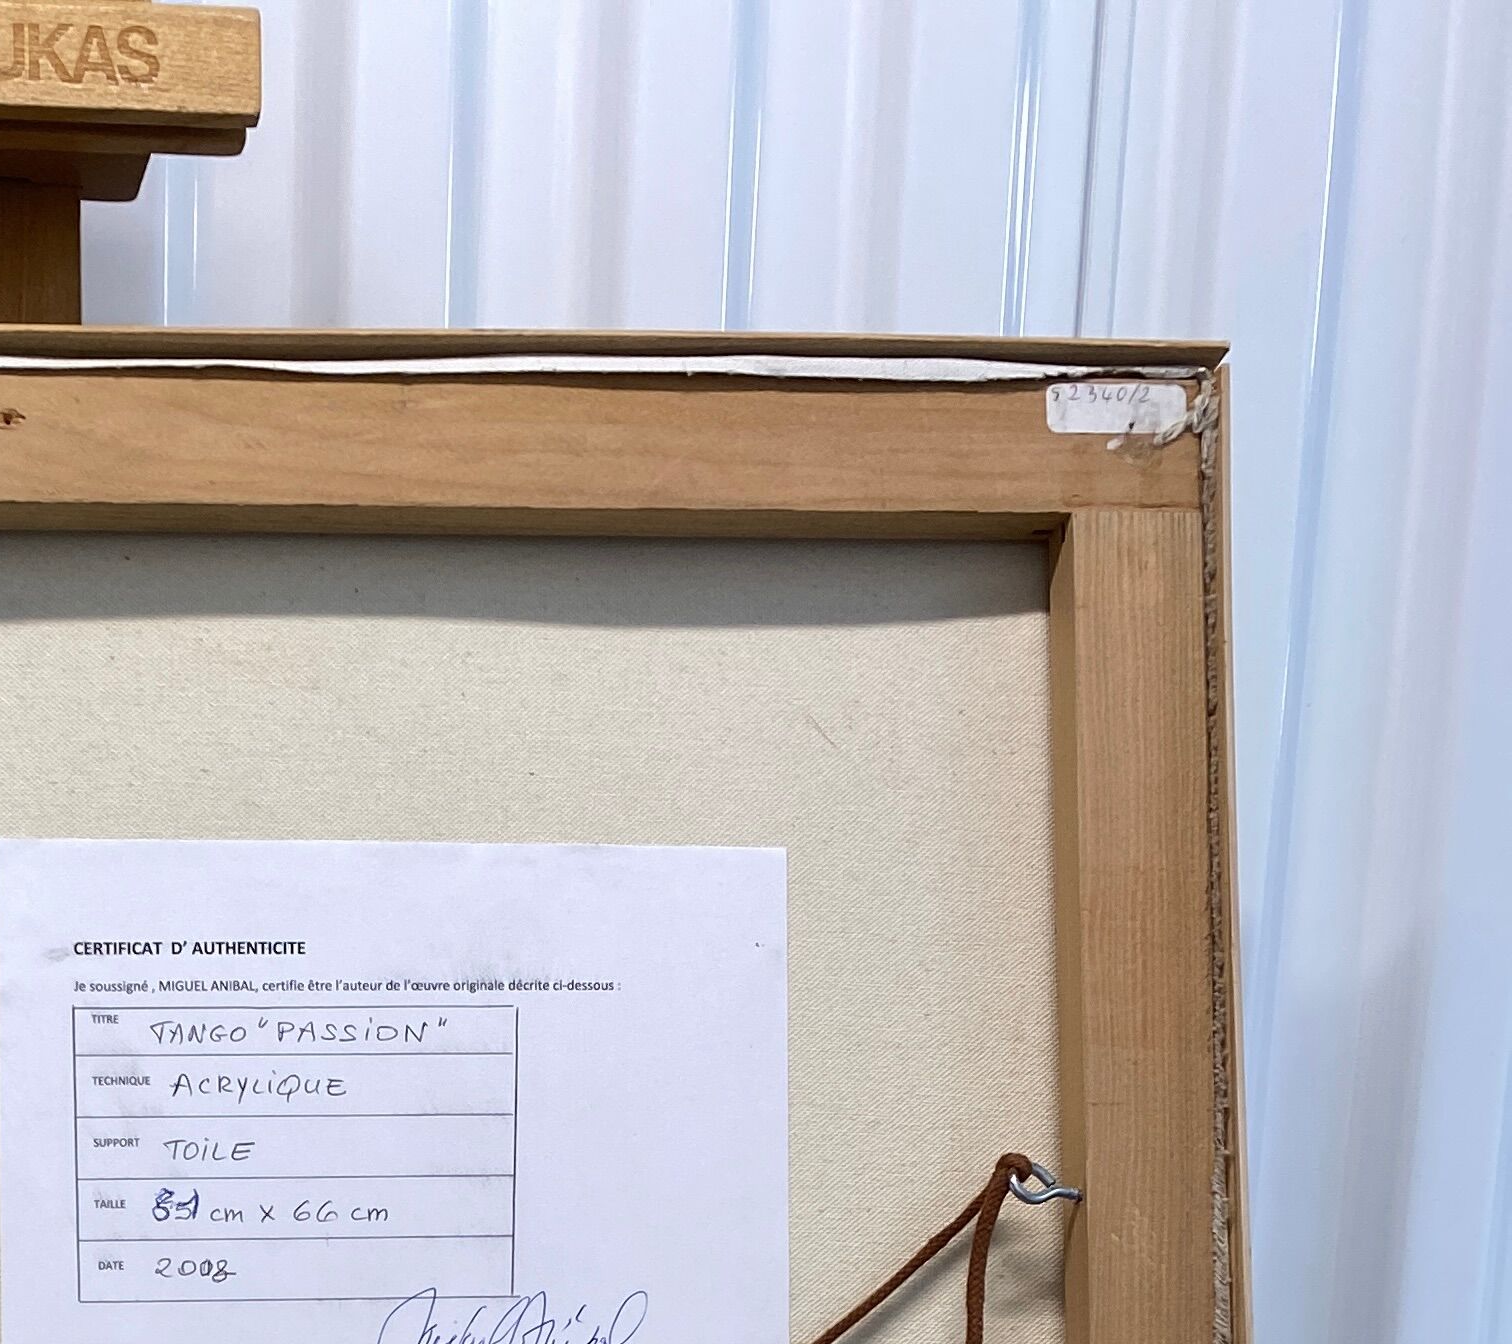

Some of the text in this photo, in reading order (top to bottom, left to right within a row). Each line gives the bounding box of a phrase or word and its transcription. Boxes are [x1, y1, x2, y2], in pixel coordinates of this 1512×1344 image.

[73, 941, 162, 956] CERTIFICAT
[191, 941, 307, 956] AUTHENTICITE
[73, 980, 87, 993] Je
[89, 978, 149, 996] soussigné
[158, 980, 209, 992] MIGUEL
[210, 980, 259, 995] ANIBAL,
[261, 979, 305, 992] certifie
[307, 979, 333, 992] être
[335, 979, 383, 992] l'auteur
[385, 979, 401, 991] de
[403, 978, 450, 991] l'œuvre
[453, 978, 505, 994] originale
[507, 978, 550, 991] décrite
[552, 978, 615, 991] ci-dessous
[91, 1014, 119, 1024] TITRE
[150, 1020, 247, 1045] TANGO
[92, 1076, 151, 1086] TECHNIQUE
[93, 1137, 140, 1147] SUPPORT
[94, 1199, 126, 1209] TAILLE
[210, 1208, 243, 1223] cm
[293, 1200, 338, 1222] 66
[350, 1205, 388, 1222] cm
[98, 1260, 124, 1270] DATE
